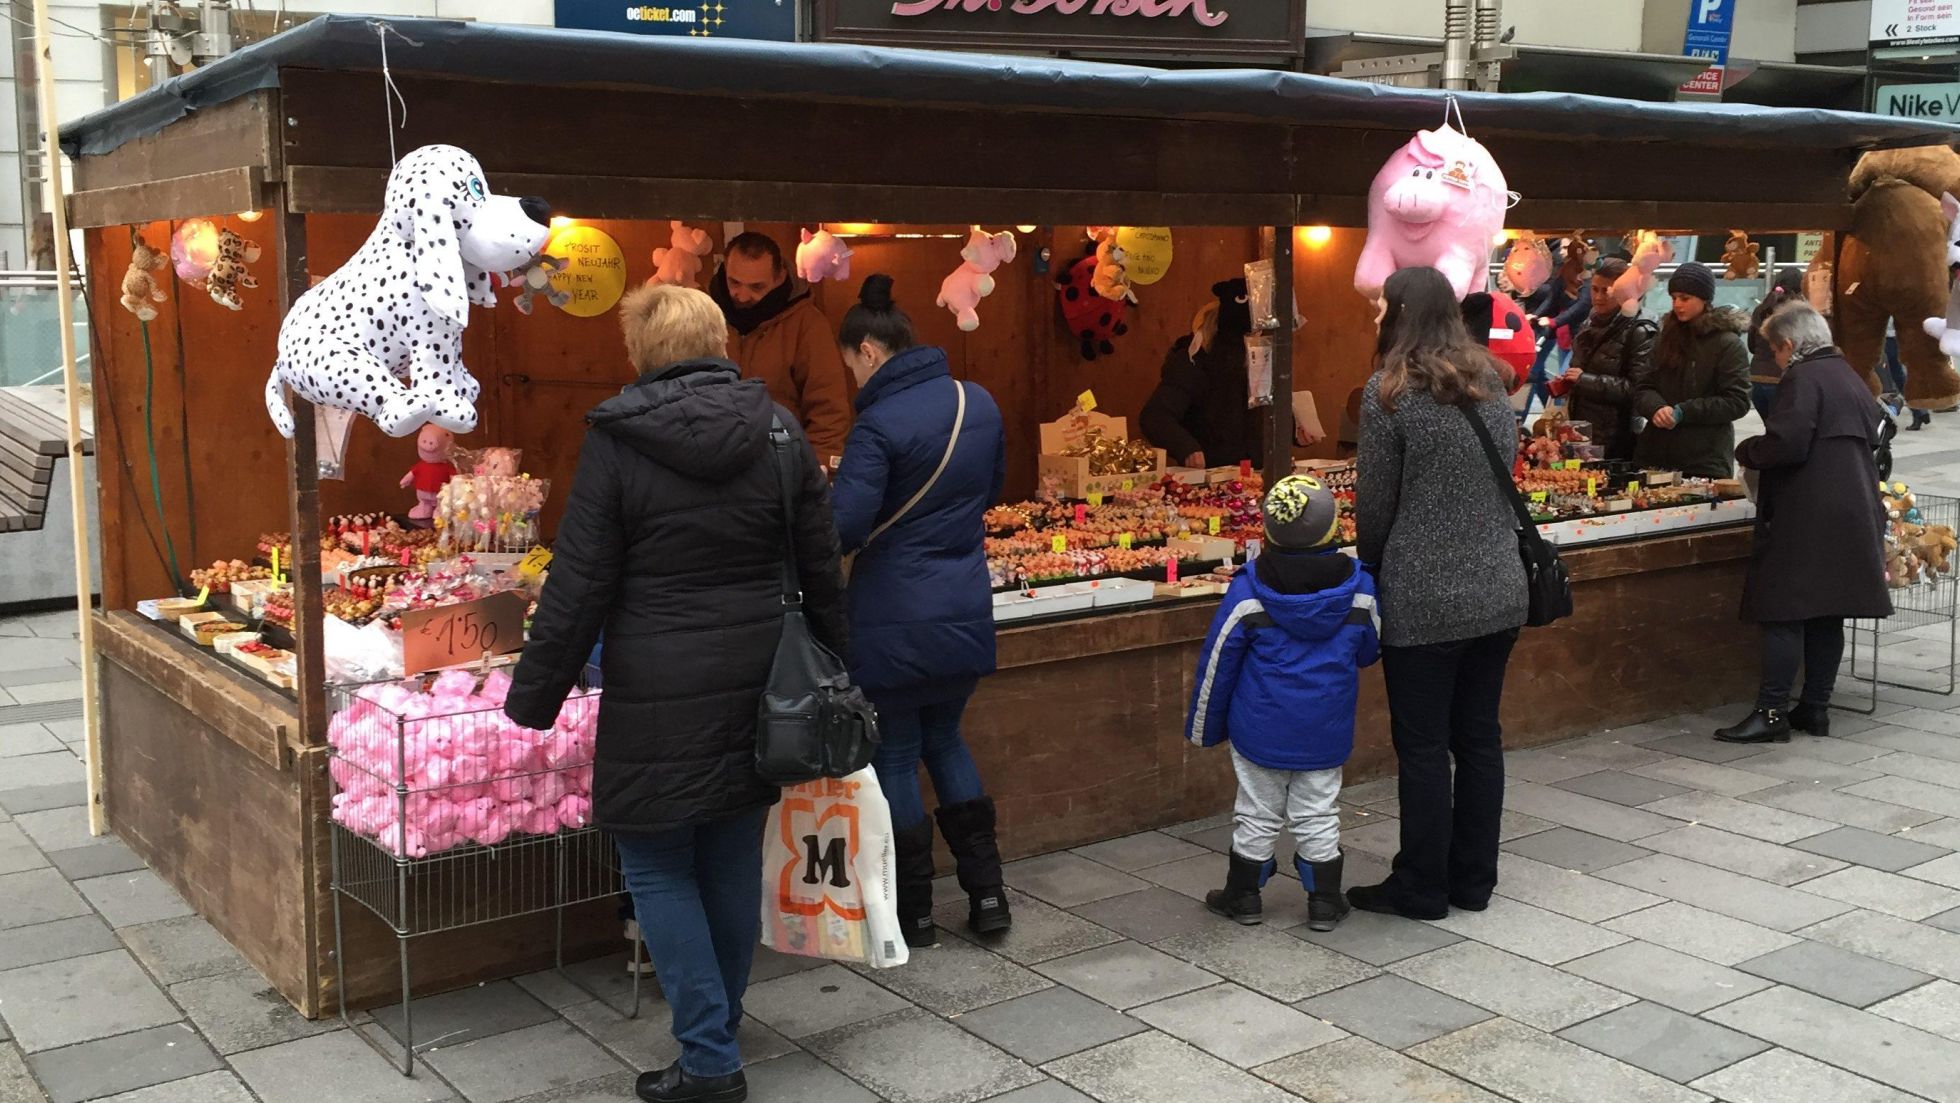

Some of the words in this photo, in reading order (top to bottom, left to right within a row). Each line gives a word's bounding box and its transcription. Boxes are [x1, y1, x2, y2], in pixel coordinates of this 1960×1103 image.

[626, 6, 697, 23] oeticket.com
[1937, 12, 1952, 20] sein
[1915, 24, 1937, 32] Stock
[577, 256, 620, 269] NEUJAHR
[550, 272, 571, 285] APPY
[576, 274, 593, 283] NEW
[572, 288, 599, 304] YEAR
[802, 834, 851, 888] M
